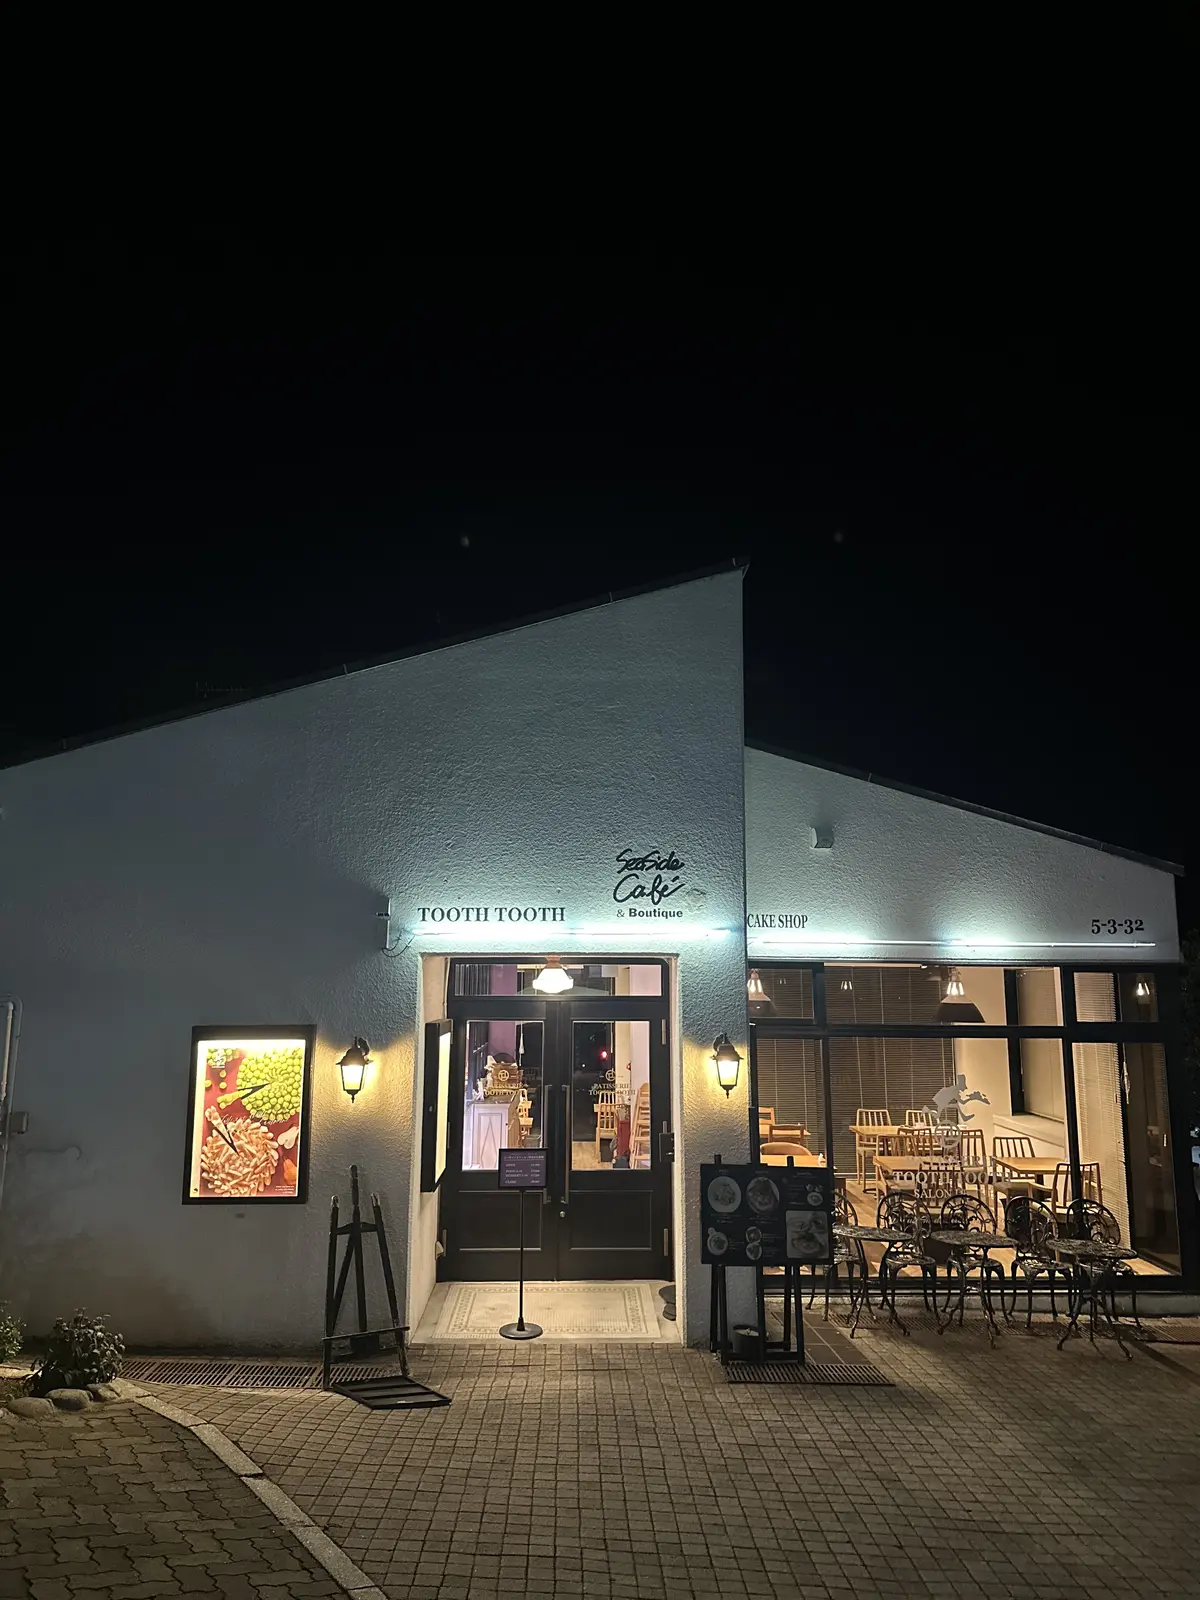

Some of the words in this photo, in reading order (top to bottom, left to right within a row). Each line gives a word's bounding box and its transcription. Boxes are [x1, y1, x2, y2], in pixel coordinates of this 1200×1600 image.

[613, 874, 686, 905] Café
[418, 907, 488, 922] TOOTH
[495, 907, 566, 922] TOOTH
[616, 909, 625, 918] &
[628, 907, 683, 919] Boutique
[747, 914, 776, 928] CAKE
[778, 914, 808, 929] SHOP
[1091, 918, 1145, 935] 5-3-32
[892, 1171, 951, 1185] TOOTH
[914, 1188, 952, 1199] SALON
